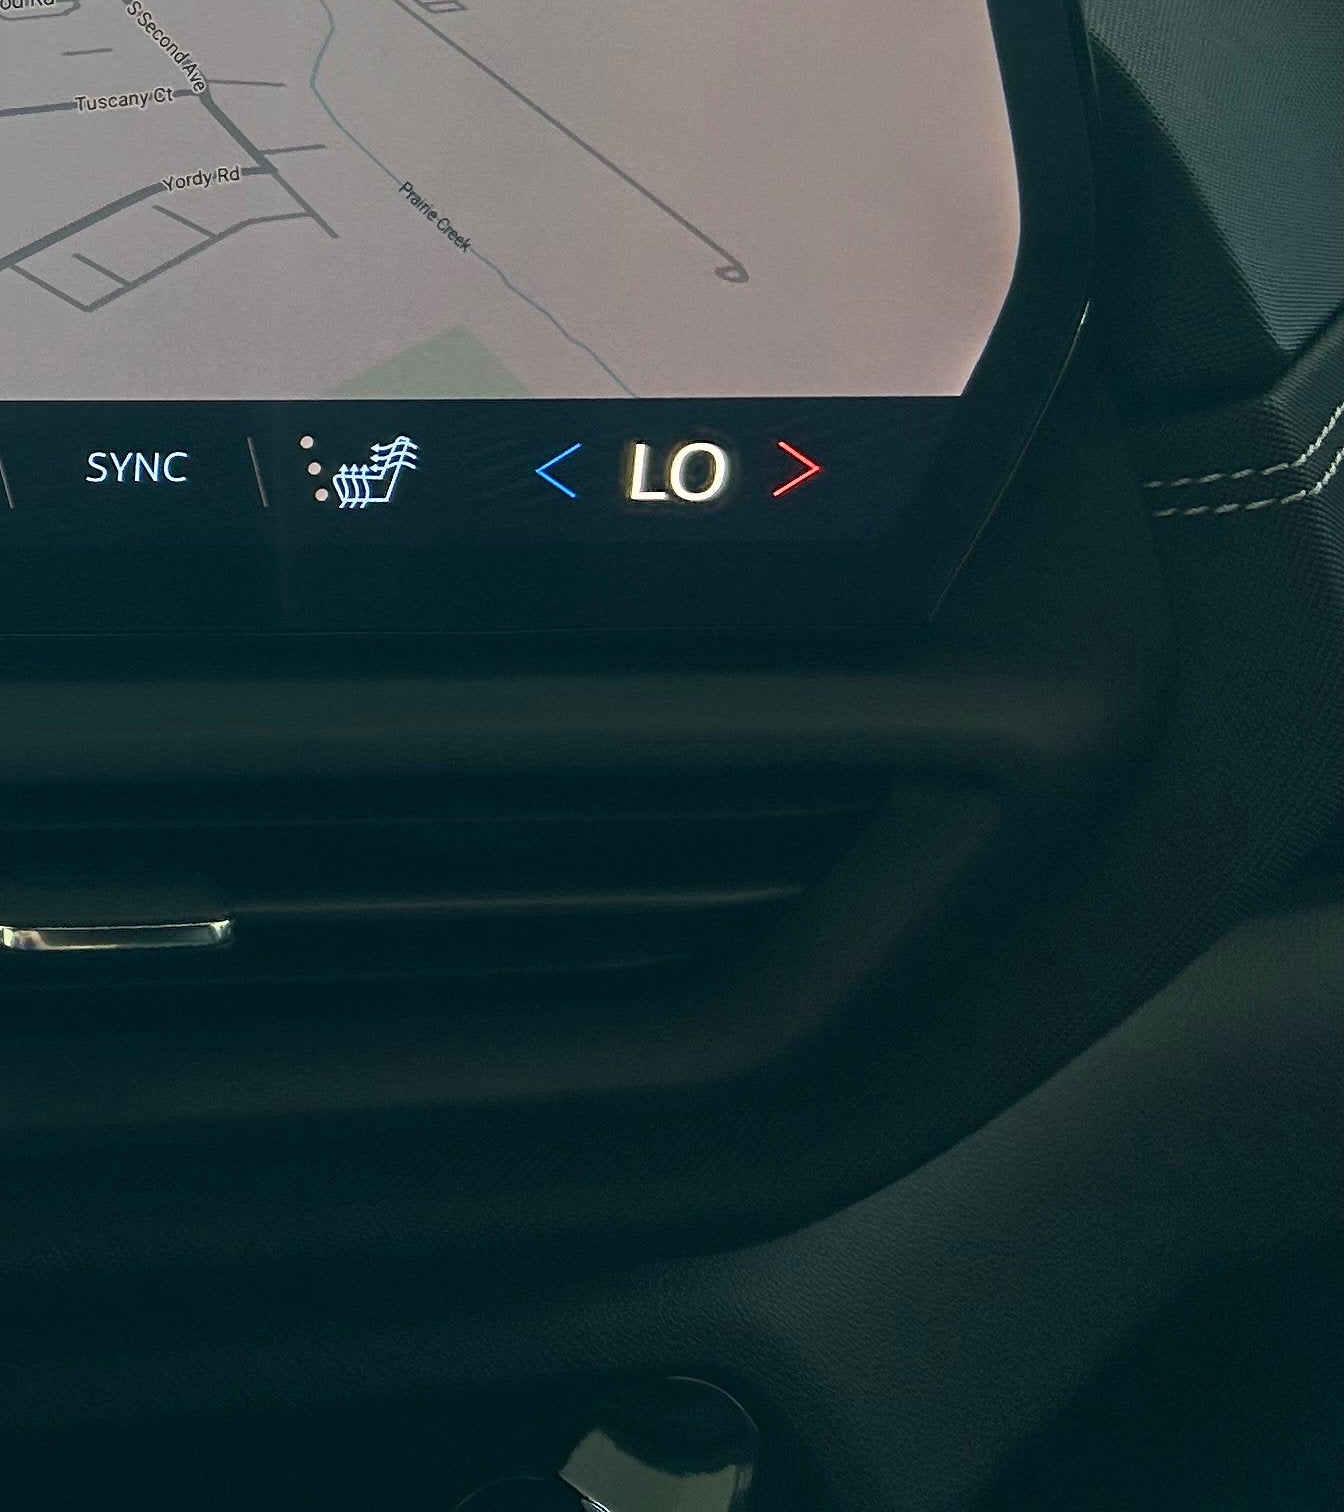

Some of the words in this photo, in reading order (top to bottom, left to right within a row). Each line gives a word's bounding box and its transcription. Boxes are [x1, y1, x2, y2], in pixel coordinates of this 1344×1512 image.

[127, 0, 141, 16] S
[137, 12, 190, 64] Second
[184, 62, 205, 93] Ave
[75, 94, 150, 112] Tuscany
[154, 88, 174, 103] Ct
[163, 170, 213, 191] Yordy
[217, 166, 240, 182] Rd
[398, 180, 438, 222] Prairie
[436, 217, 472, 254] Creek
[85, 451, 190, 485] SYNC
[629, 441, 730, 504] LO
